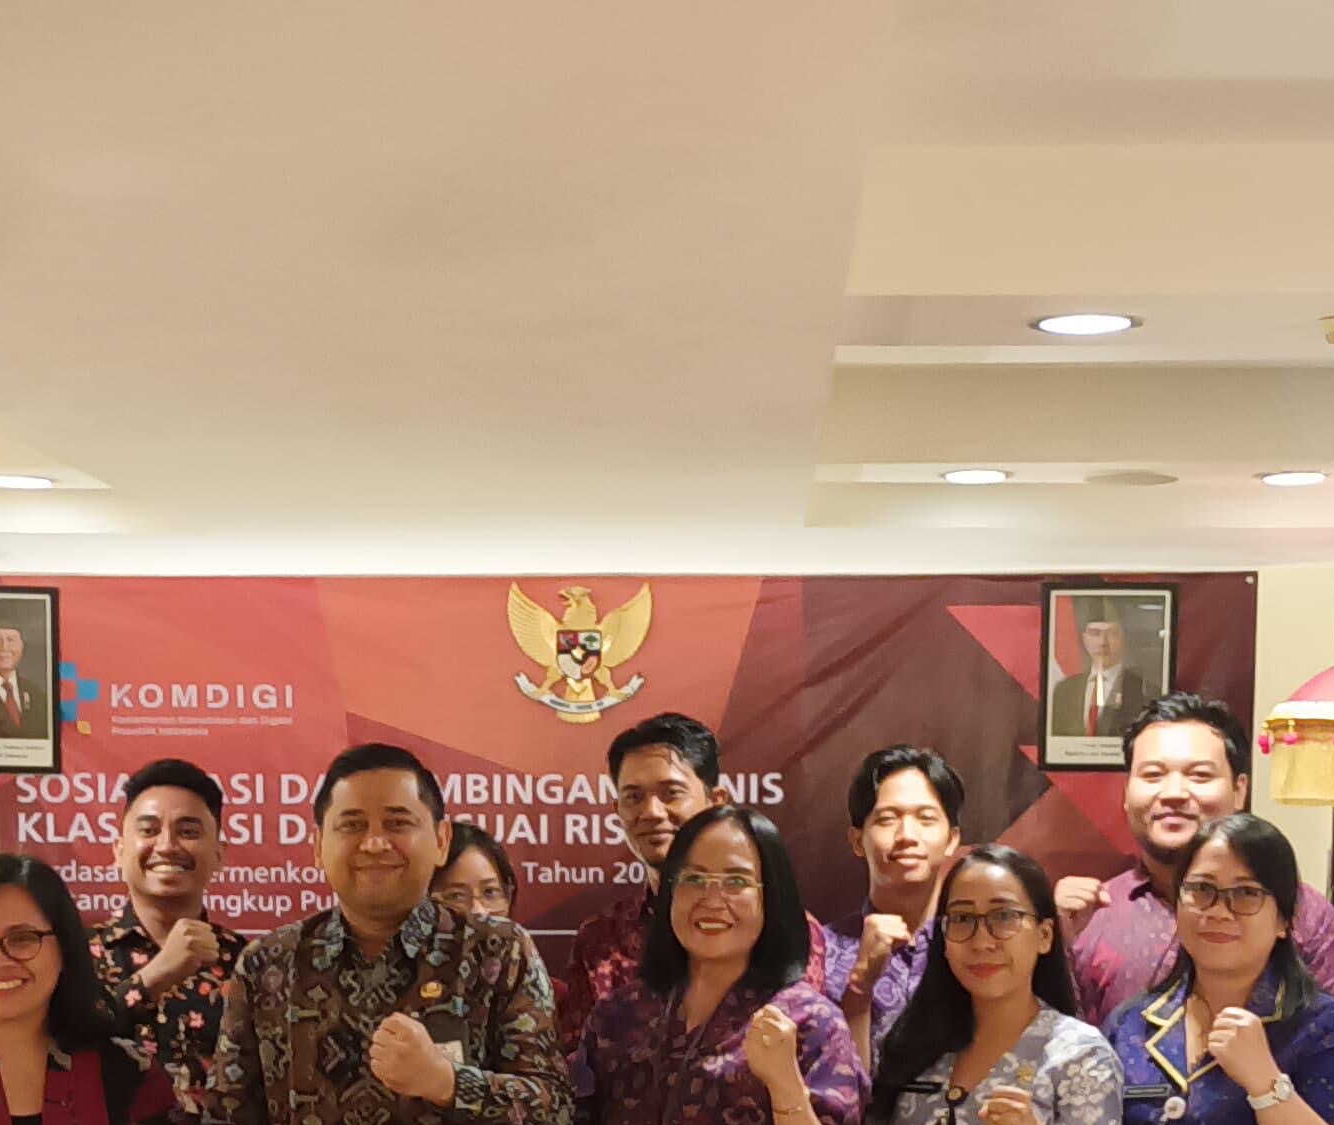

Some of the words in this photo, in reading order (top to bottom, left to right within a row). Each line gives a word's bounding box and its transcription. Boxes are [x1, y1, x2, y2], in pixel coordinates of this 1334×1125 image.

[110, 683, 294, 709] KOMDIGI
[434, 773, 620, 805] MBINGAN
[718, 772, 785, 805] NIS
[564, 812, 627, 846] RIS
[520, 861, 605, 884] Tahun
[612, 861, 646, 884] 20
[202, 888, 293, 918] ingkup
